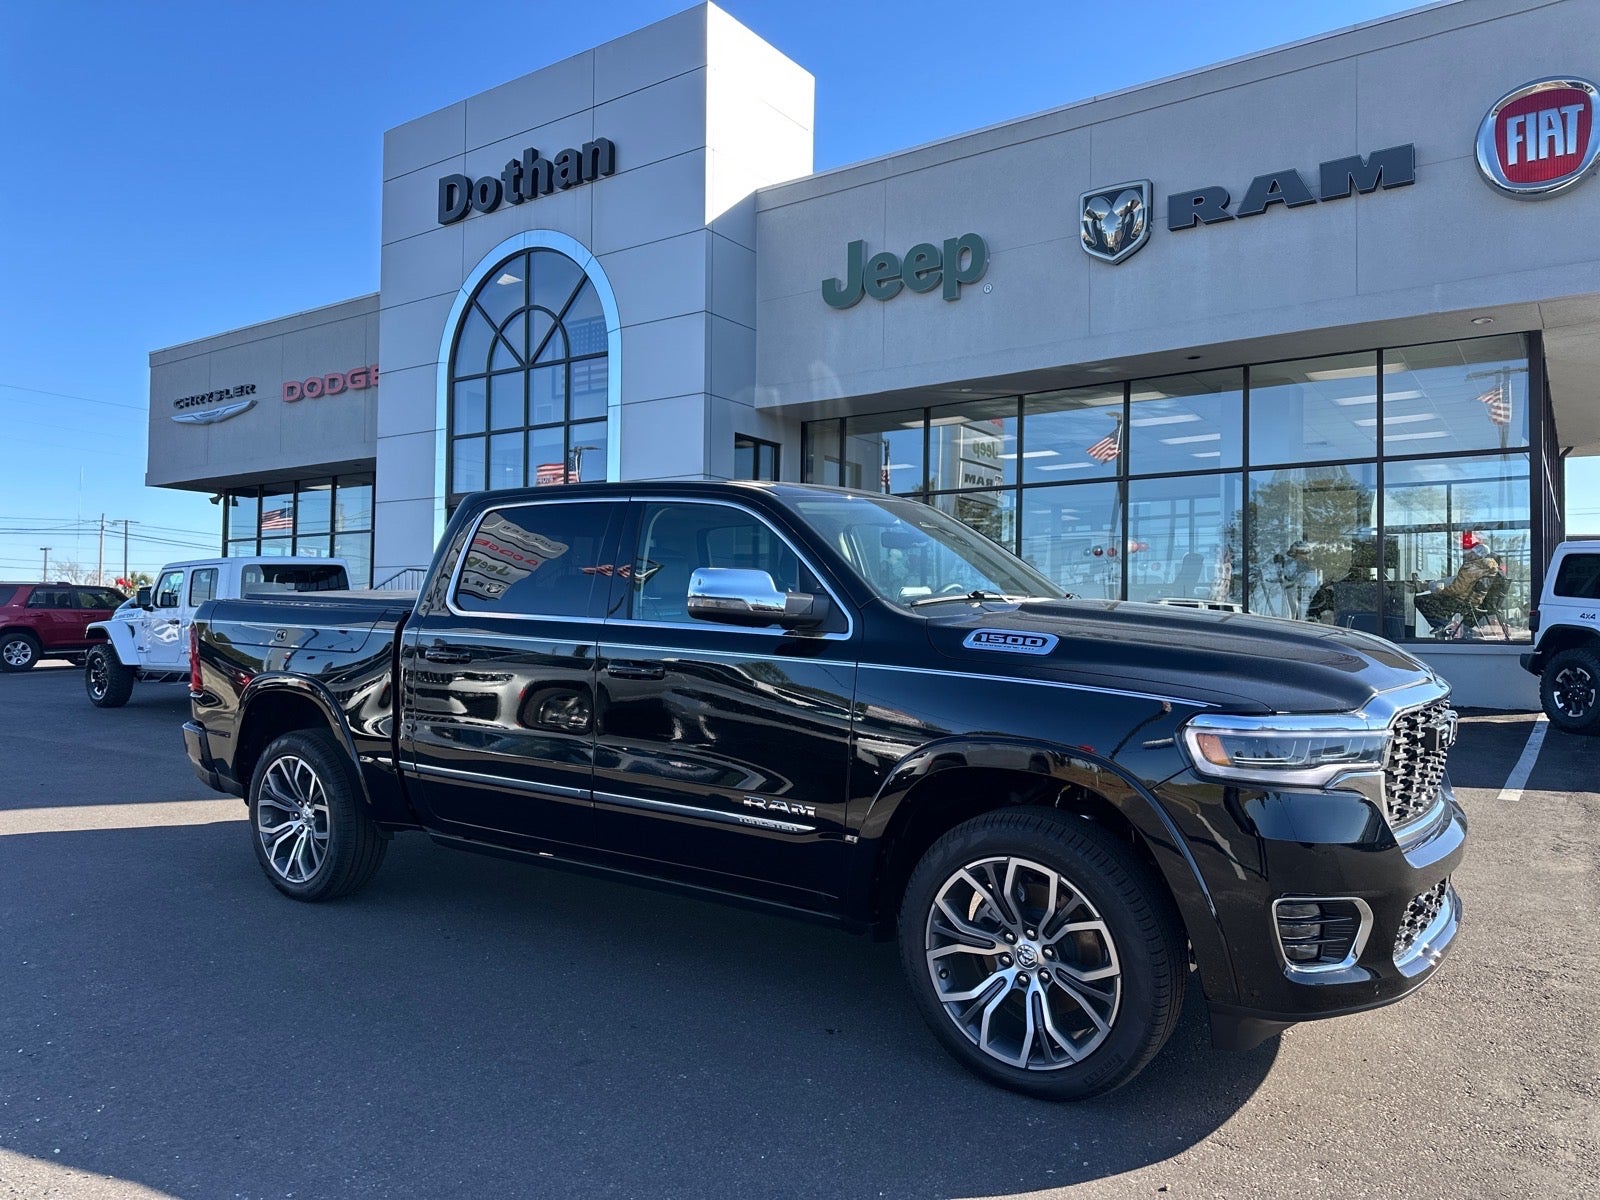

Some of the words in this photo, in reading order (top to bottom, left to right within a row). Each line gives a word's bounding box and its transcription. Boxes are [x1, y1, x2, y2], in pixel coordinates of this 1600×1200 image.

[1506, 103, 1585, 166] FIAT
[438, 137, 615, 225] Dothan
[1168, 143, 1416, 231] RAM
[822, 233, 990, 309] Jeep
[174, 384, 257, 409] CHRYSLER
[979, 632, 1044, 647] 1500
[743, 795, 817, 818] RAM
